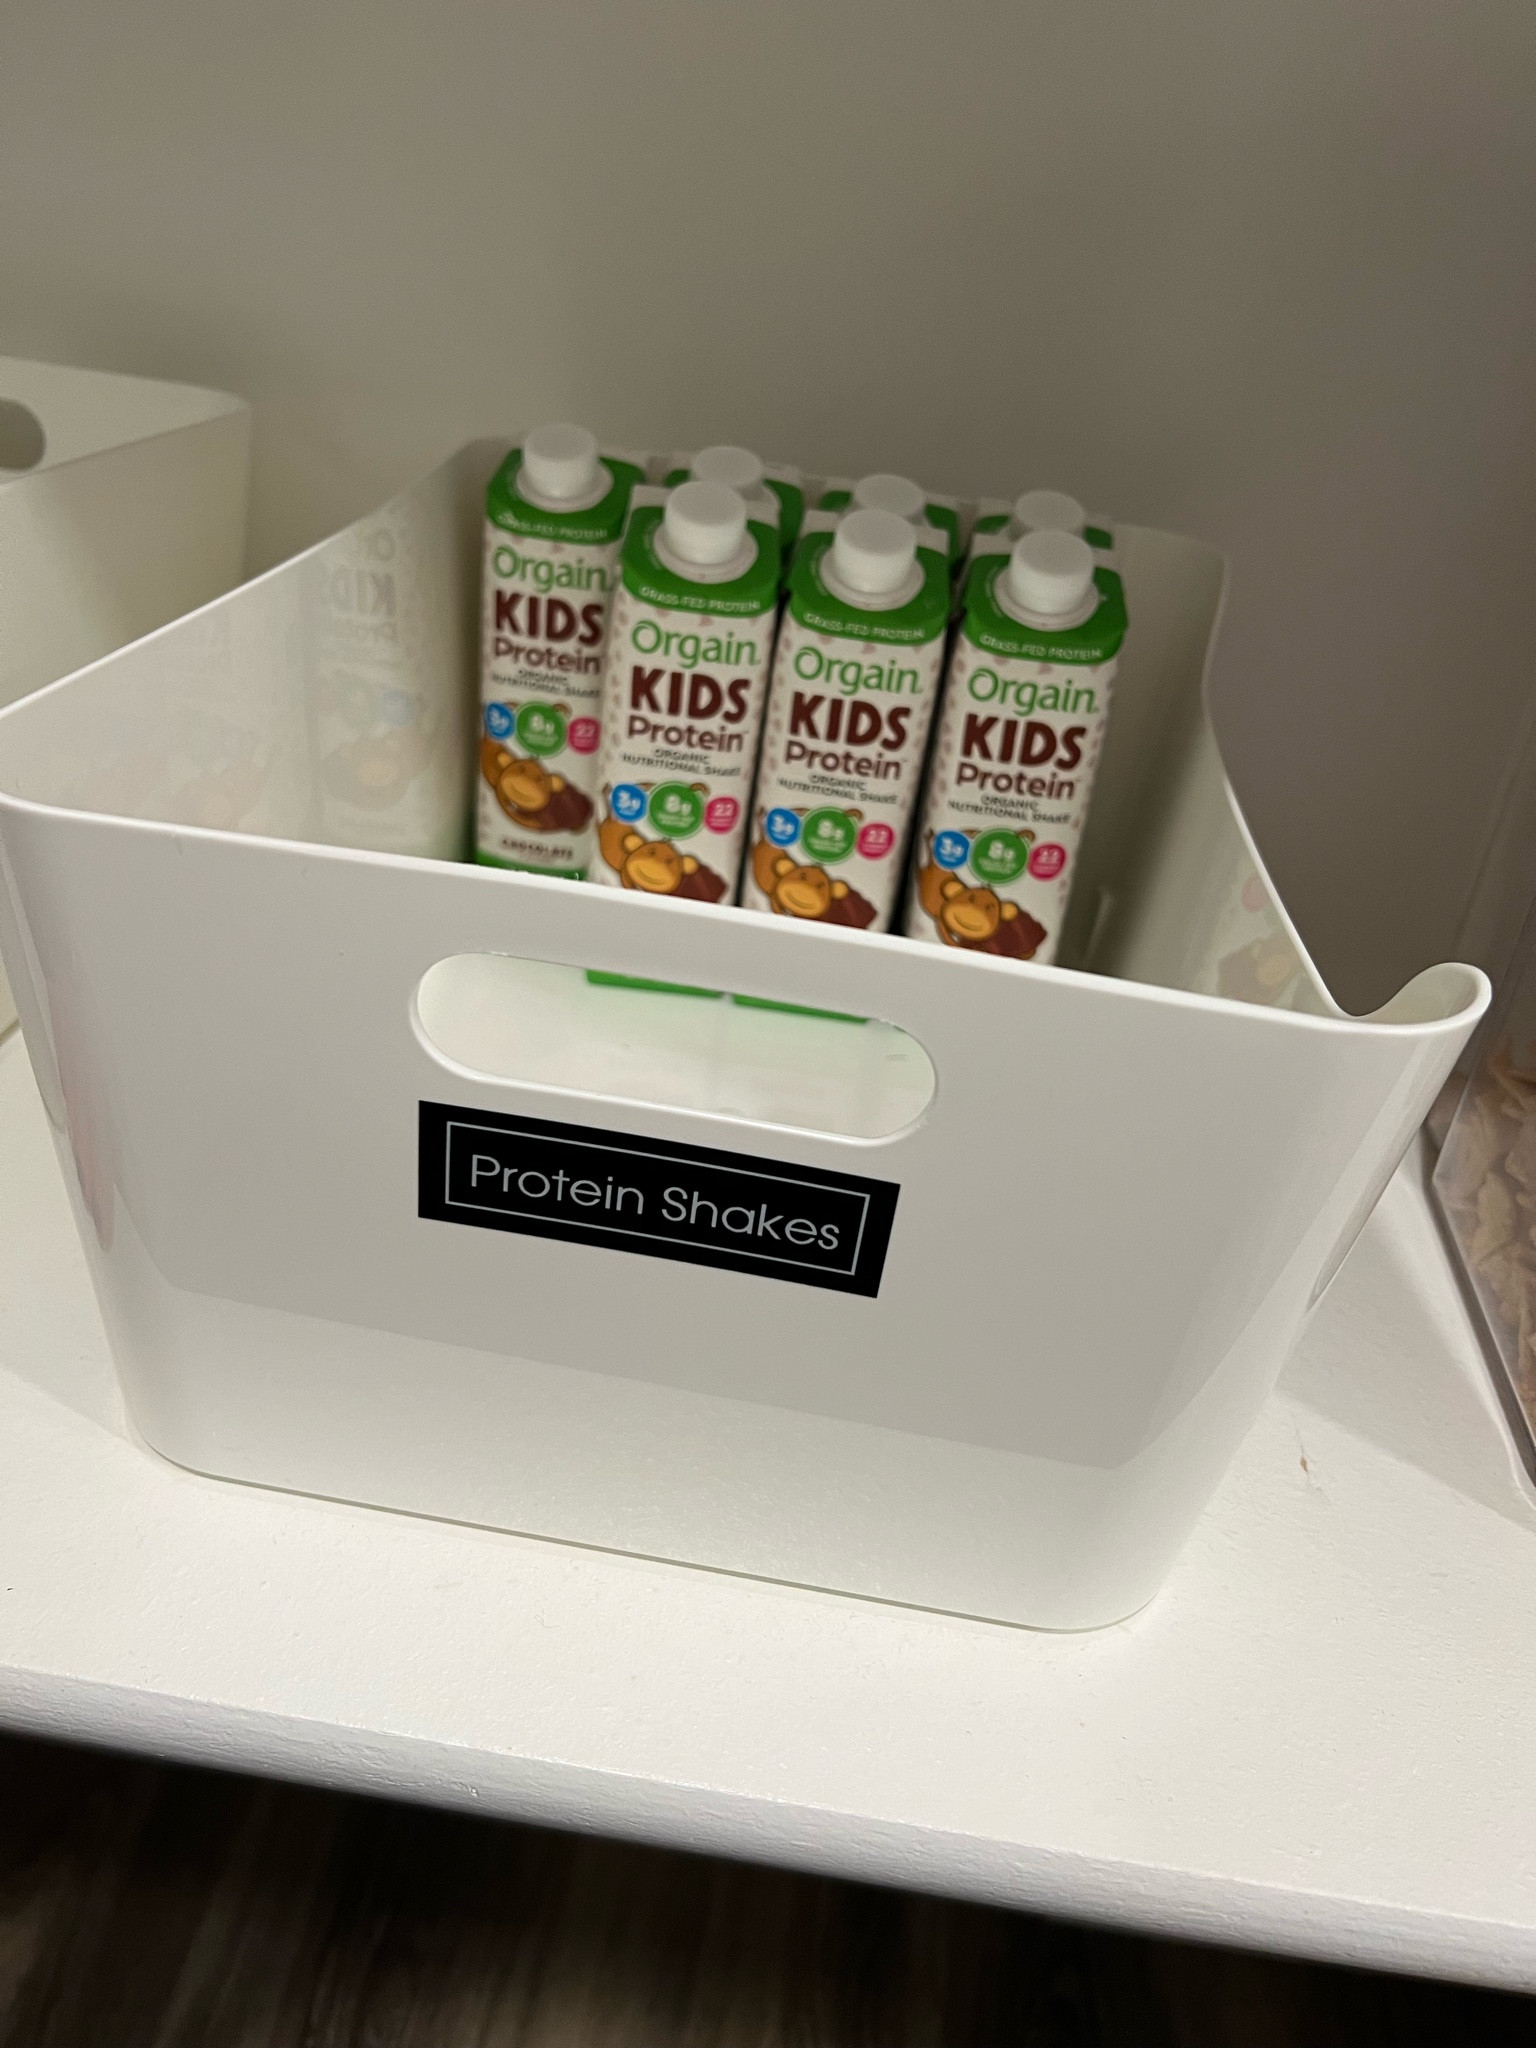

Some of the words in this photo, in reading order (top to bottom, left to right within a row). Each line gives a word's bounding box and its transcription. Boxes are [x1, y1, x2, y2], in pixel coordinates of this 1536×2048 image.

[492, 544, 610, 593] Orgain
[495, 589, 604, 646] KIDS
[495, 636, 600, 675] Protein
[631, 620, 760, 669] Orgain
[630, 665, 752, 724] KIDS
[794, 646, 921, 696] Orgain
[968, 667, 1098, 717] Orgain
[628, 714, 744, 752] Protein
[789, 690, 912, 752] KIDS
[961, 713, 1087, 772] KIDS
[786, 740, 901, 780] Protein
[956, 761, 1076, 800] Protein
[470, 1154, 645, 1215] Protein
[661, 1186, 841, 1251] Shakes
